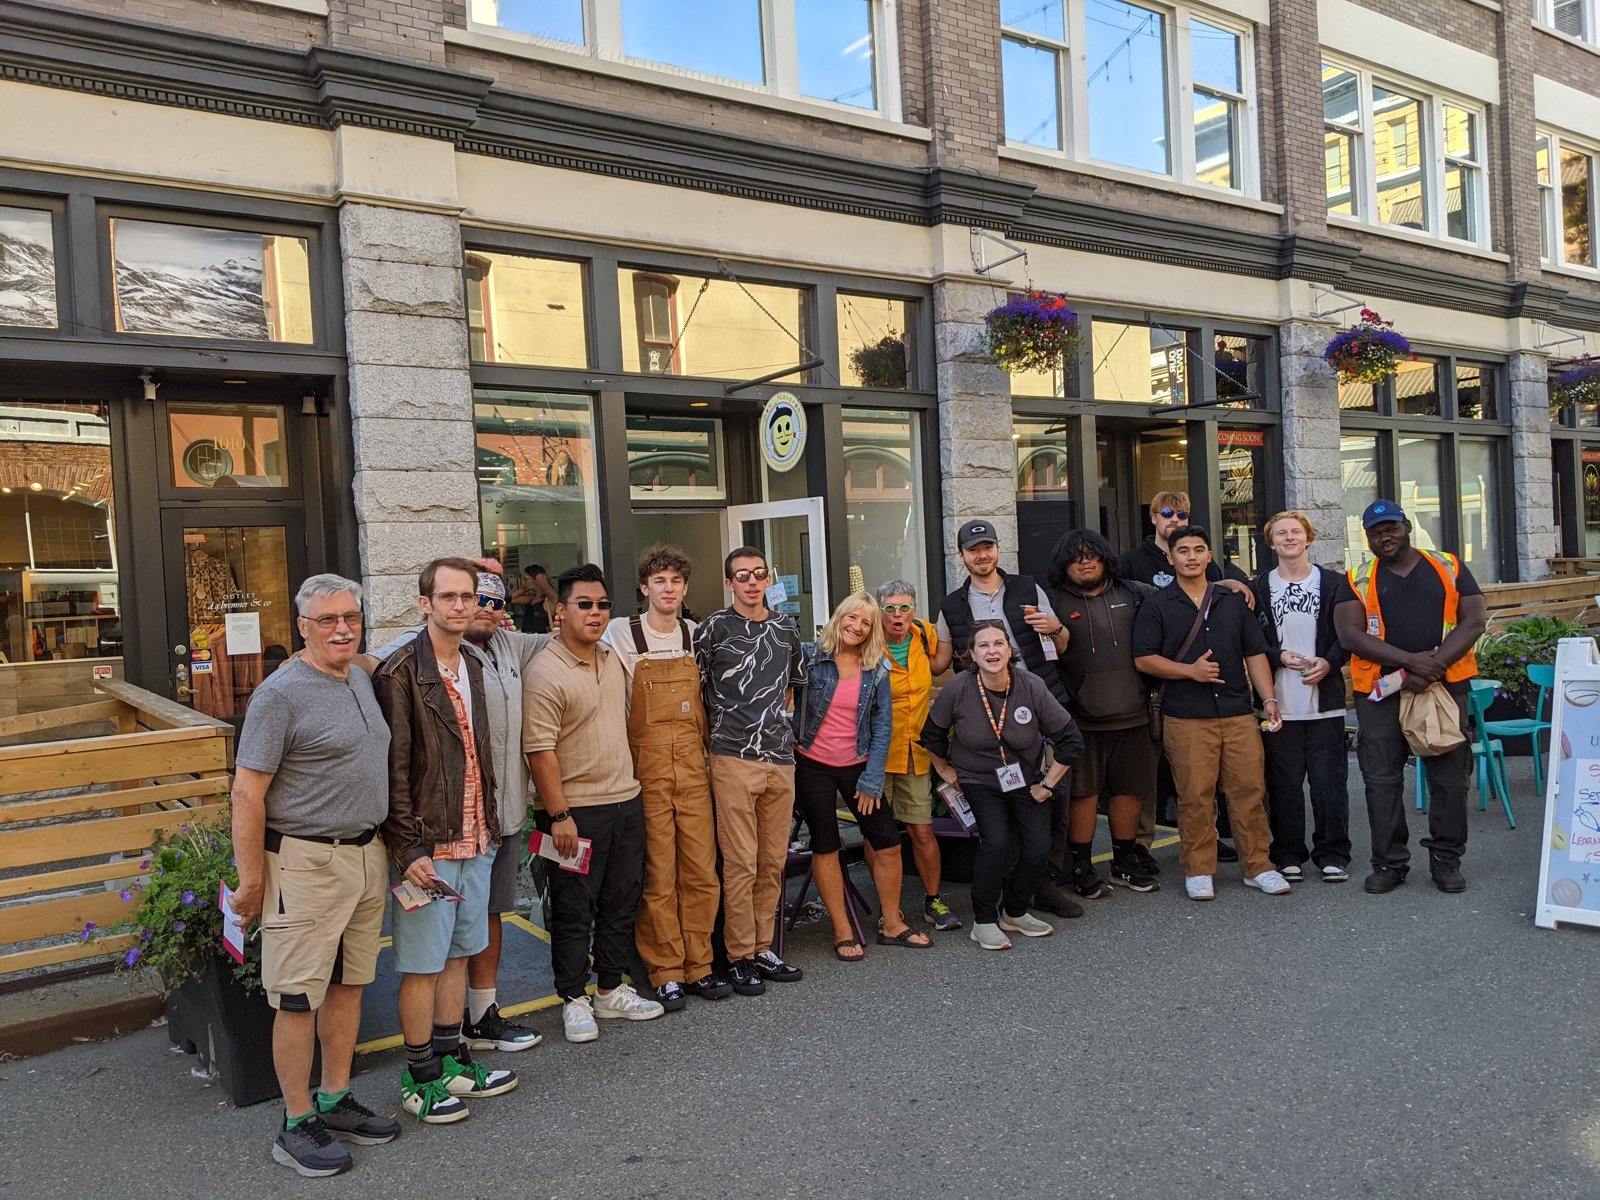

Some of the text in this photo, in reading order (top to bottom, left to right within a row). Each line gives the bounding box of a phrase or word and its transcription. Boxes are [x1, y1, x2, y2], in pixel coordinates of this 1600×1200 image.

[1218, 432, 1242, 441] COMING
[213, 435, 246, 450] 1010
[222, 592, 256, 600] OUTLET
[769, 592, 784, 603] OPEN
